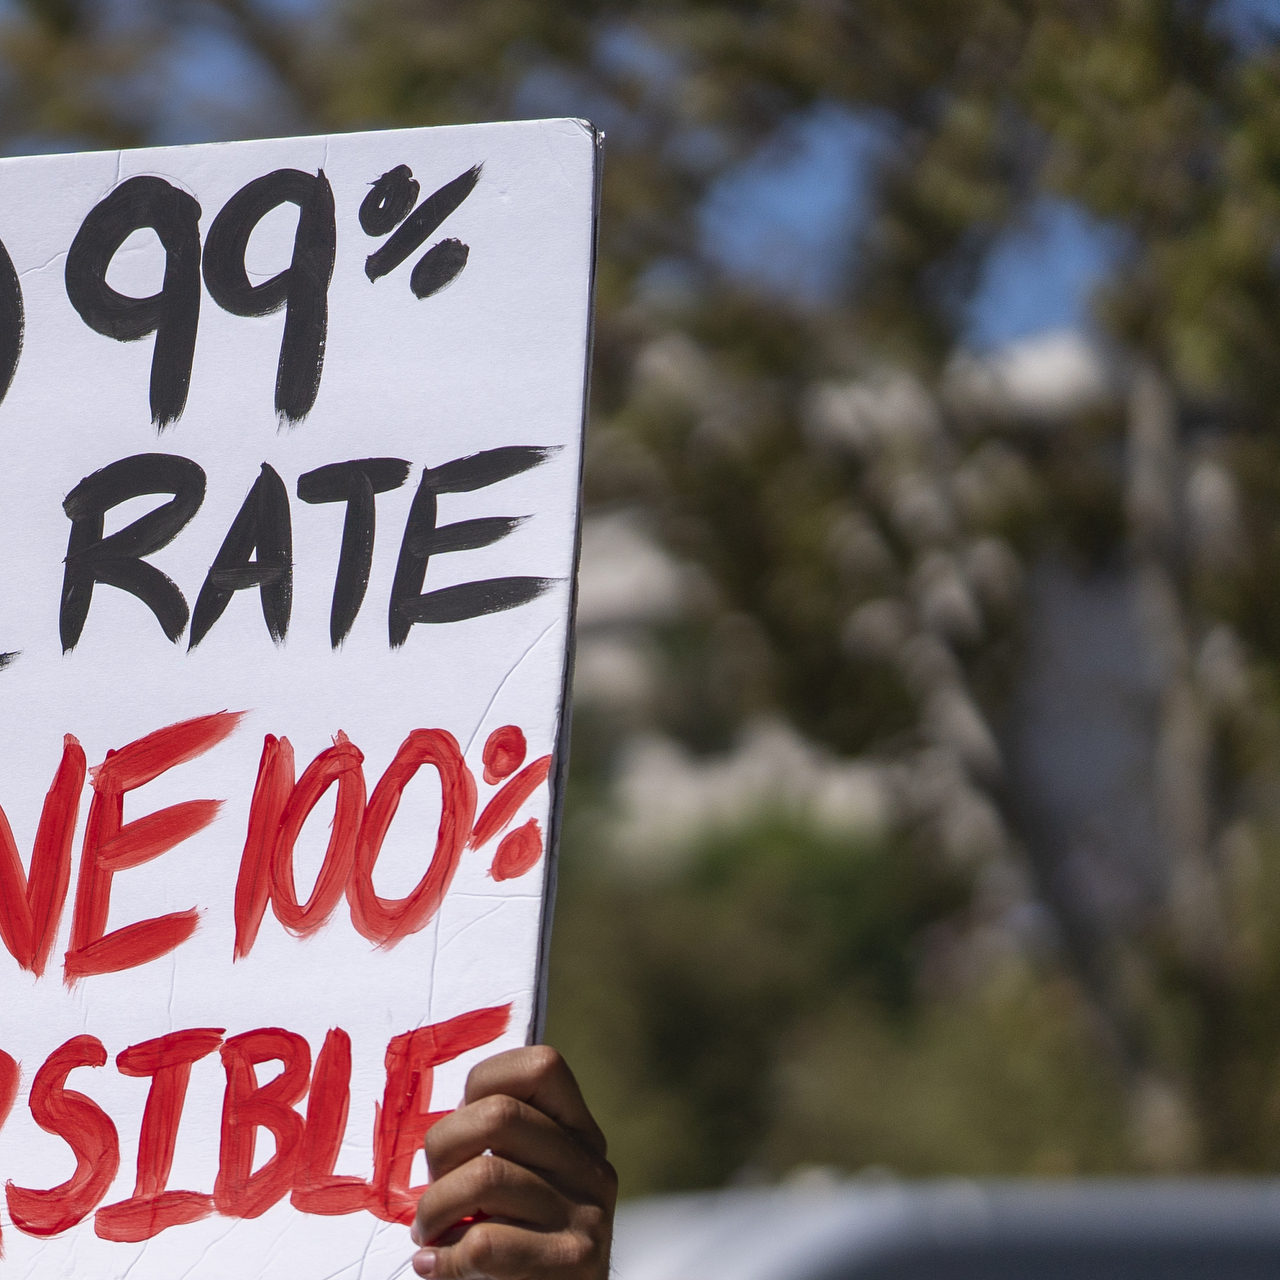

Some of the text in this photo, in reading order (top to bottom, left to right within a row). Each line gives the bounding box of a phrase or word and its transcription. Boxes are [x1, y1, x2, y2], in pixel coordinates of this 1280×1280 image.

[66, 160, 484, 431] 99%
[61, 446, 565, 651] RATE
[233, 725, 552, 960] 100%
